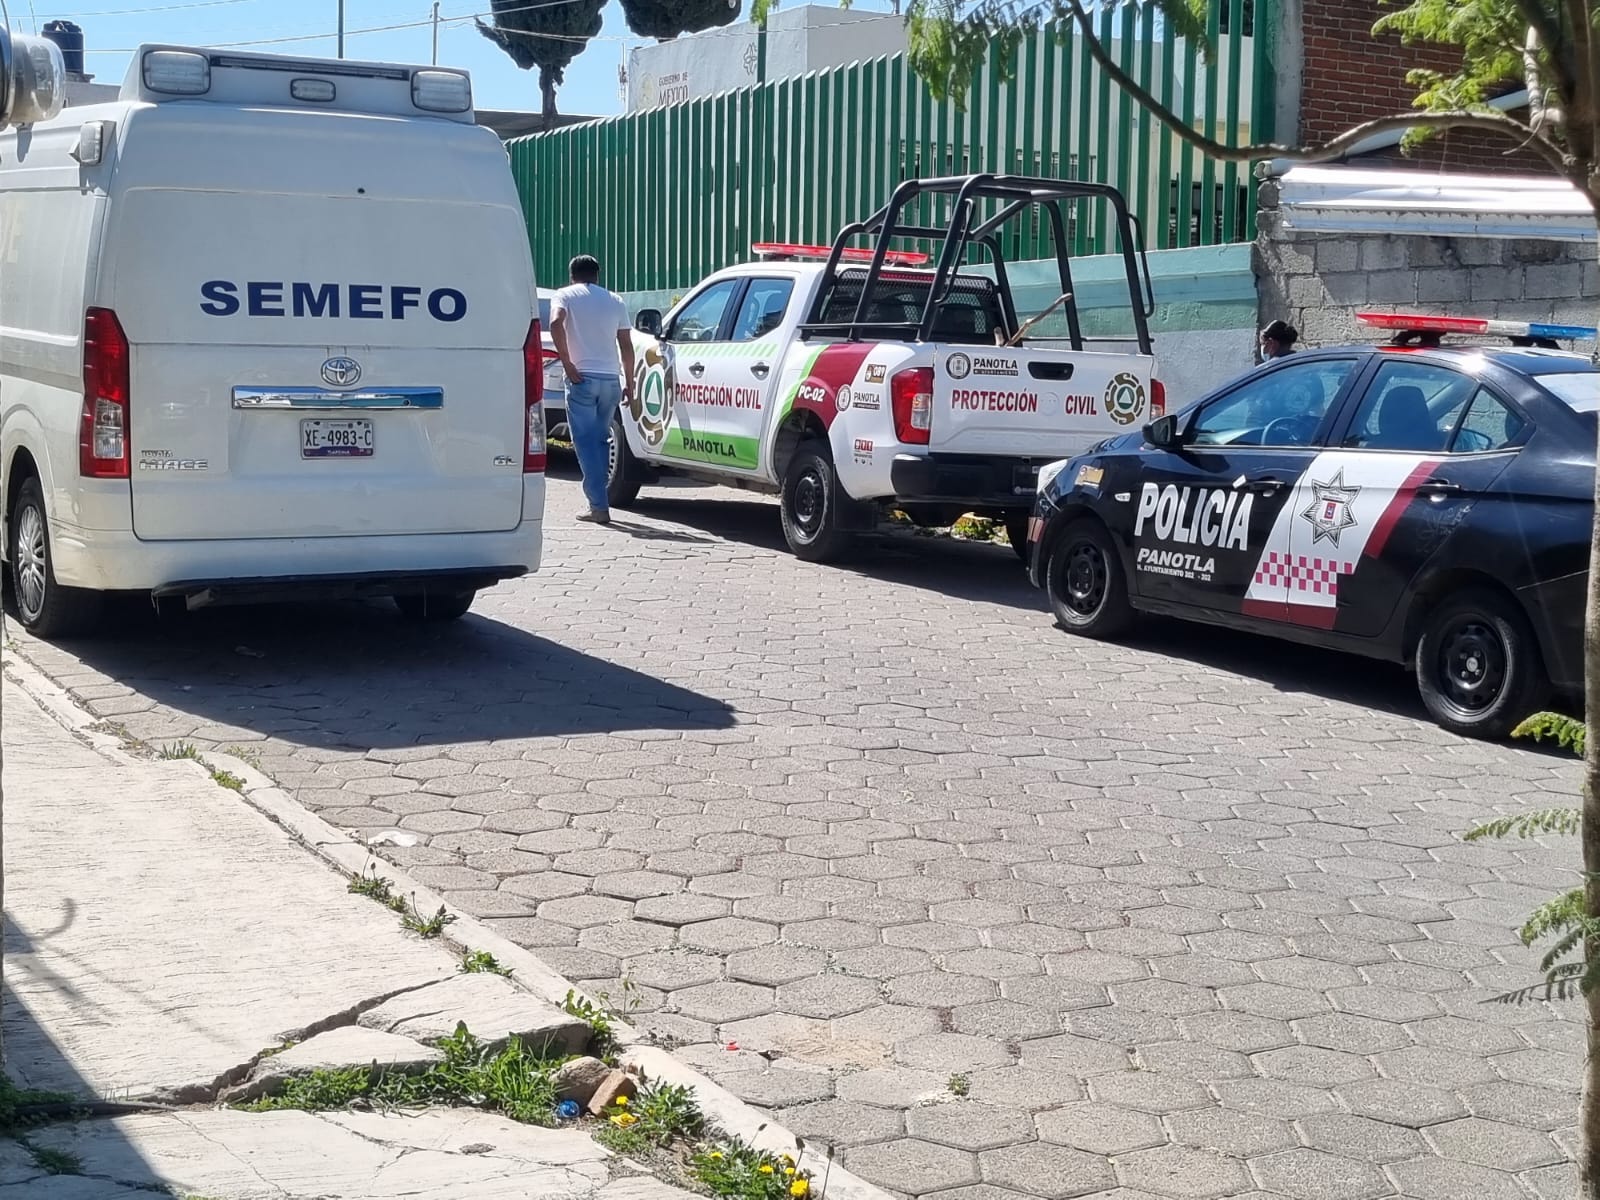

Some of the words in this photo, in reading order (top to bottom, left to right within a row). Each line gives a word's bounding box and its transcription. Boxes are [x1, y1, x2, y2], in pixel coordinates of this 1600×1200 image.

[200, 280, 468, 322] SEMEFO
[973, 358, 1018, 369] PANOTLA
[675, 382, 732, 407] PROTECCIÓN
[735, 388, 762, 409] CIVIL
[798, 385, 825, 401] PC-02
[853, 392, 880, 403] PANOTLA
[952, 388, 1038, 412] PROTECCIÓN
[1065, 395, 1097, 415] CIVIL
[305, 430, 371, 446] XE-4983-C
[683, 437, 736, 458] PANOTLA
[139, 459, 208, 470] HIACE
[1134, 474, 1254, 551] POLICÍA
[1137, 548, 1214, 573] PANOTLA
[1144, 565, 1184, 577] AYUNTAMIENTO
